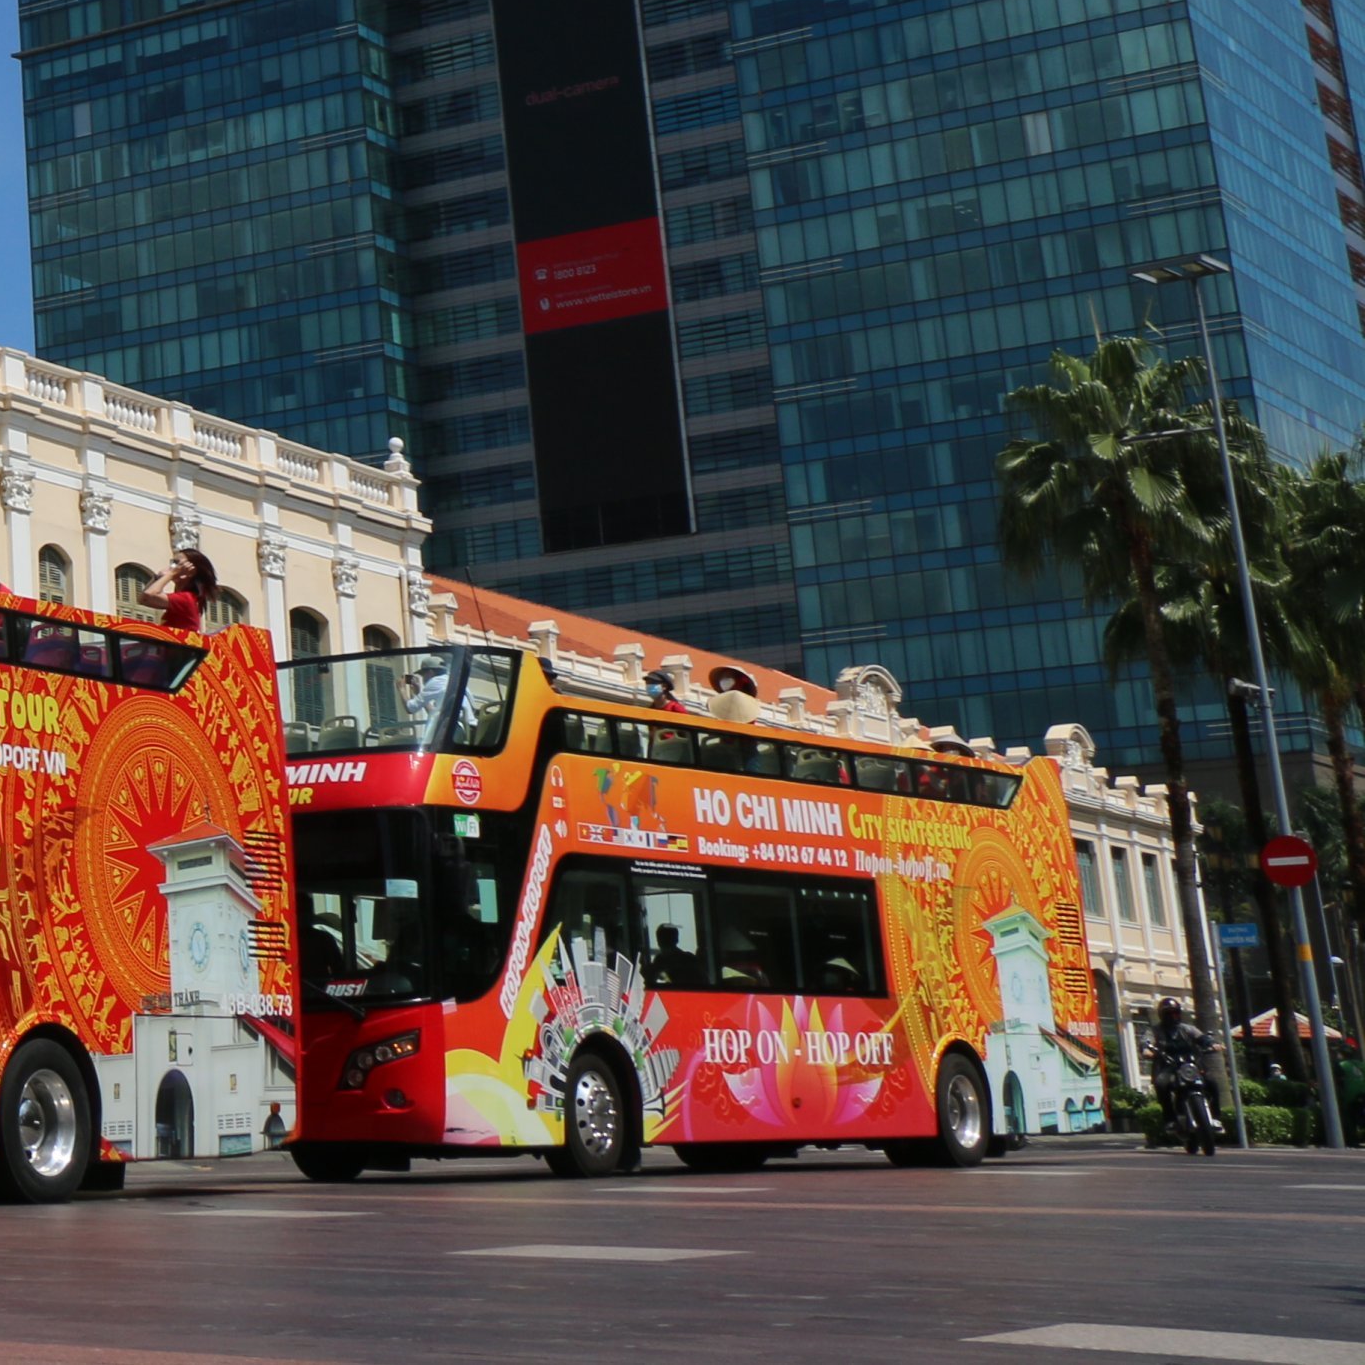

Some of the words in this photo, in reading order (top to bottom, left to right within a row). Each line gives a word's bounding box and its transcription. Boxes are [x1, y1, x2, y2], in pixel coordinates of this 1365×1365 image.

[285, 761, 367, 785] MINH
[288, 787, 314, 805] UR
[693, 787, 731, 827] HO
[735, 792, 779, 831] CHI
[781, 797, 844, 837] MINH
[887, 816, 973, 851] SIGHTSEEING
[697, 836, 750, 863] Booking:
[752, 842, 775, 862] +84
[776, 844, 799, 864] 913
[801, 846, 815, 865] 67
[817, 847, 832, 867] 44
[834, 849, 849, 868] 12
[221, 993, 293, 1017] 3B-038.73
[702, 1027, 753, 1065] HOP
[756, 1029, 791, 1066] ON
[804, 1031, 851, 1065] HOP
[855, 1031, 895, 1066] OFF
